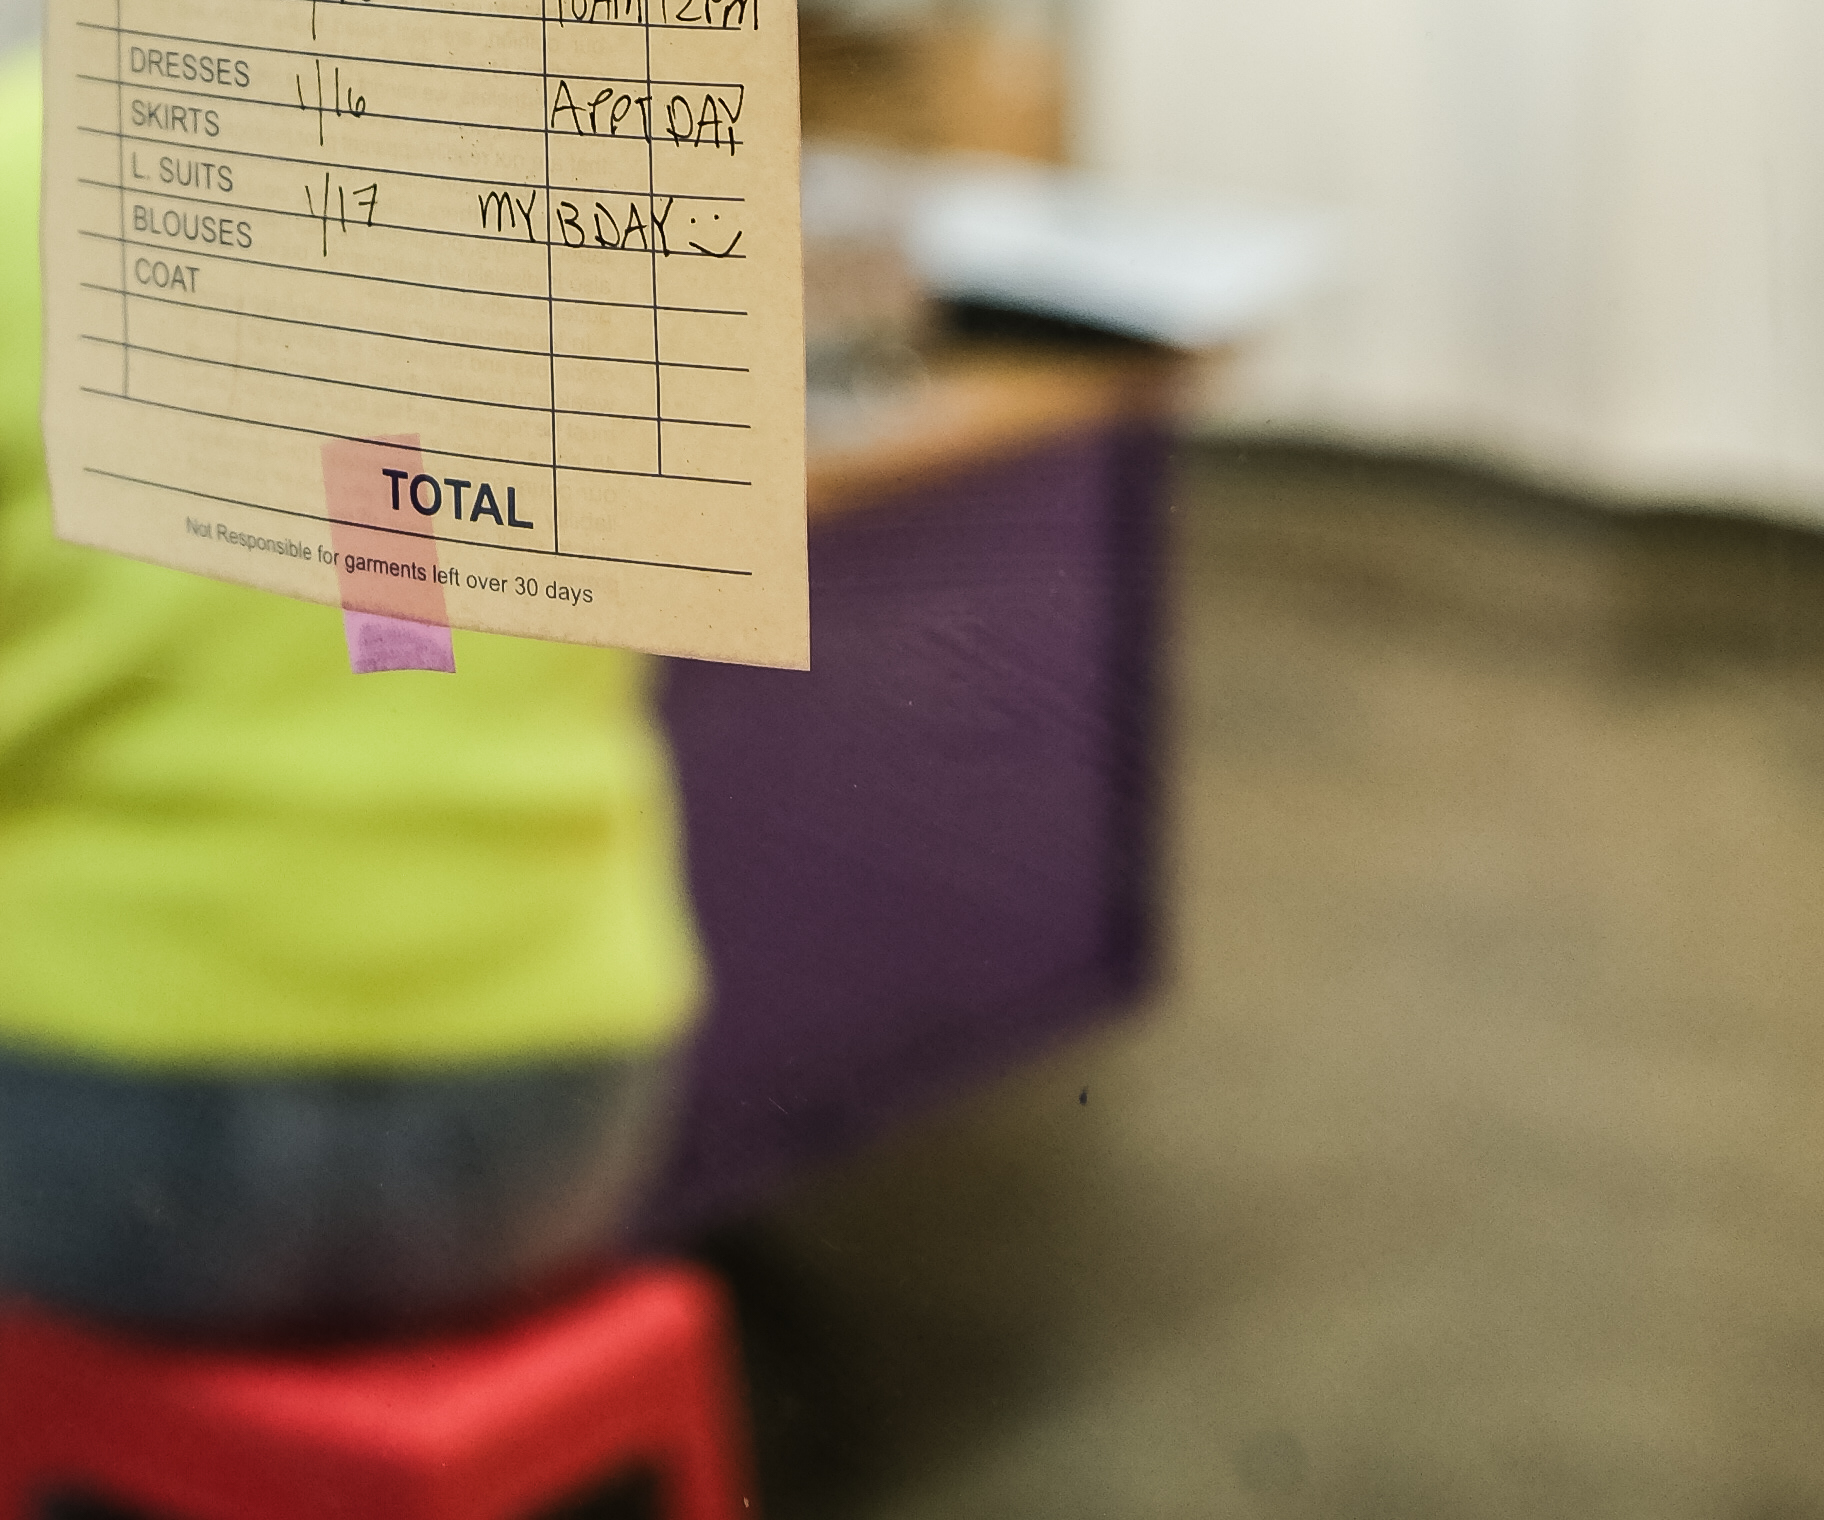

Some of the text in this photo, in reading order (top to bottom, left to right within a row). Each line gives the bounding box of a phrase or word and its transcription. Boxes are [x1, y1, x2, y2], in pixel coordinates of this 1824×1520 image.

[128, 45, 252, 89] DRESSES
[129, 99, 222, 139] SKIRTS
[130, 154, 235, 194] L. SUITS
[132, 203, 254, 250] BLOUSES
[133, 257, 201, 295] COAT
[381, 468, 535, 530] TOTAL
[185, 515, 595, 606] Not Responsible for garments left over 30 days
